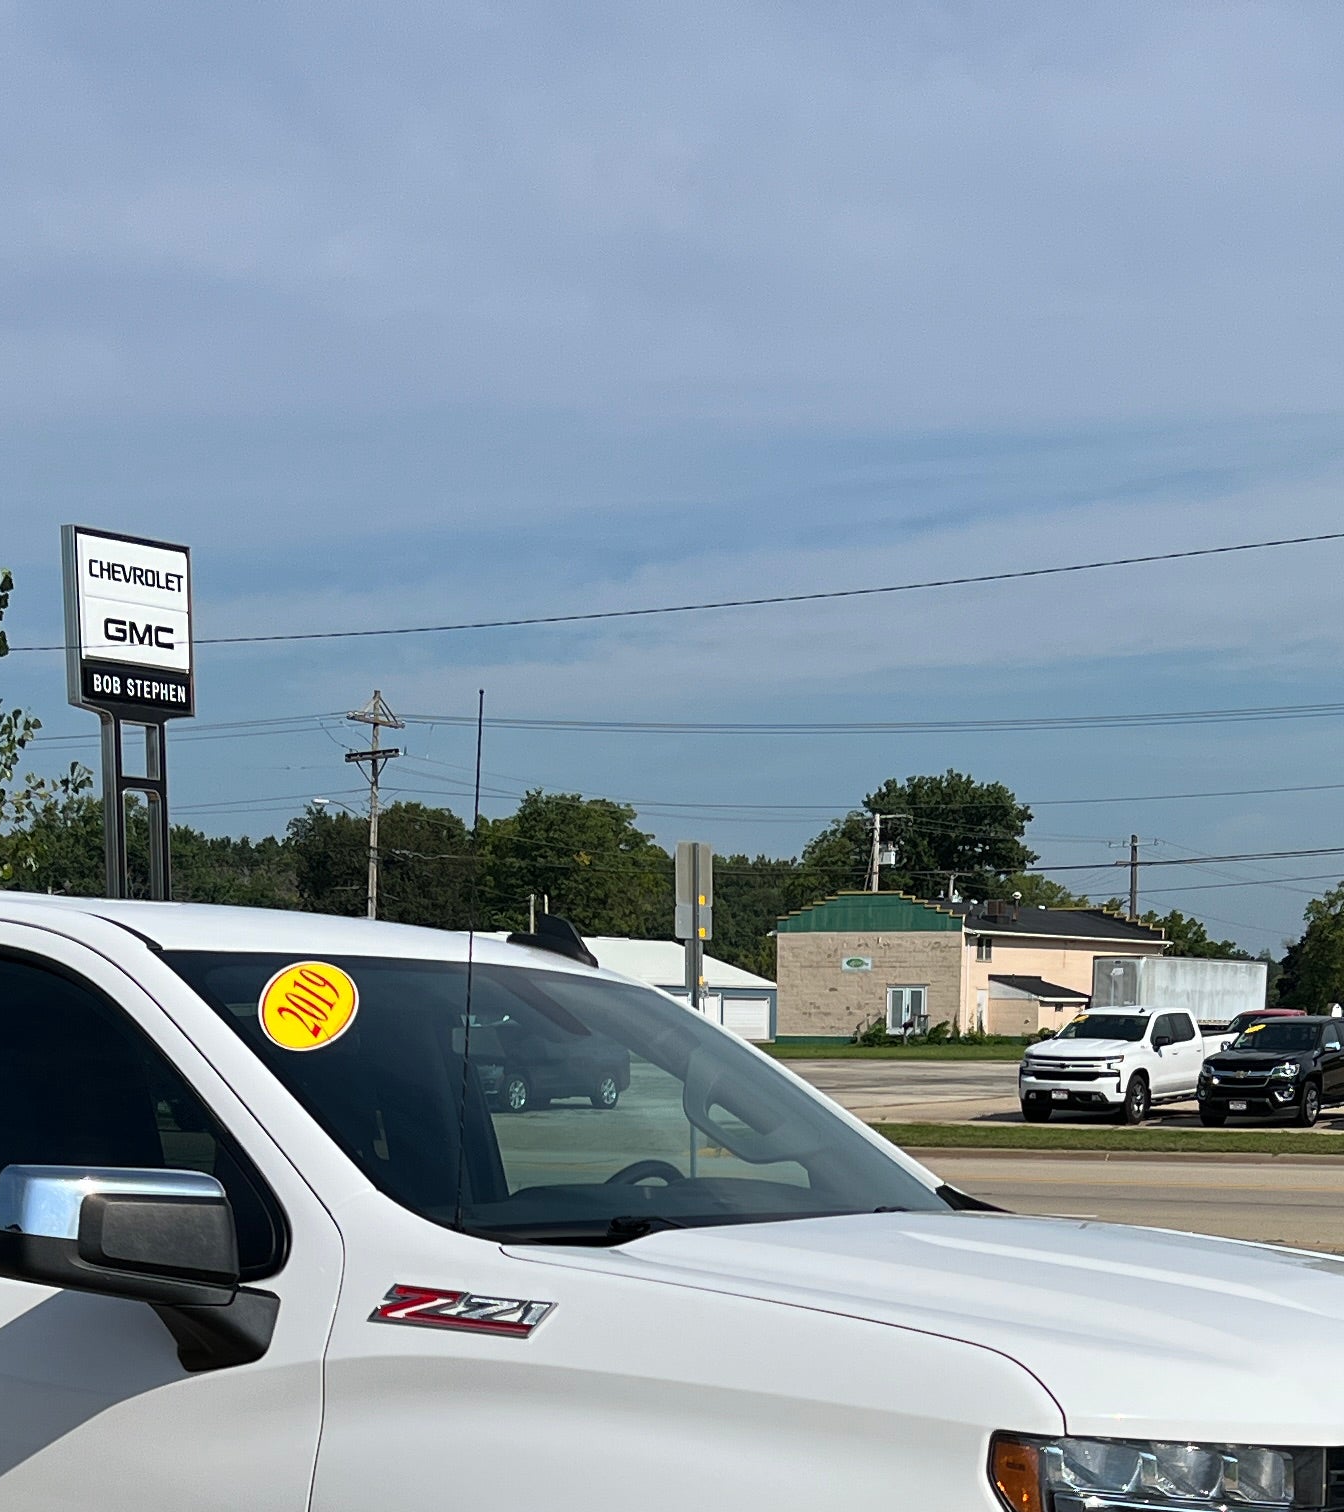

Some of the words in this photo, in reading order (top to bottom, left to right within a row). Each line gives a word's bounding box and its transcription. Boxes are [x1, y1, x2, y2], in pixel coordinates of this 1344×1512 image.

[88, 558, 183, 592] CHEVROLET
[104, 617, 174, 650] GMC
[93, 673, 121, 694] BOB
[126, 678, 186, 702] STEPHEN
[277, 969, 339, 1038] 2019
[367, 1283, 559, 1339] Z71
